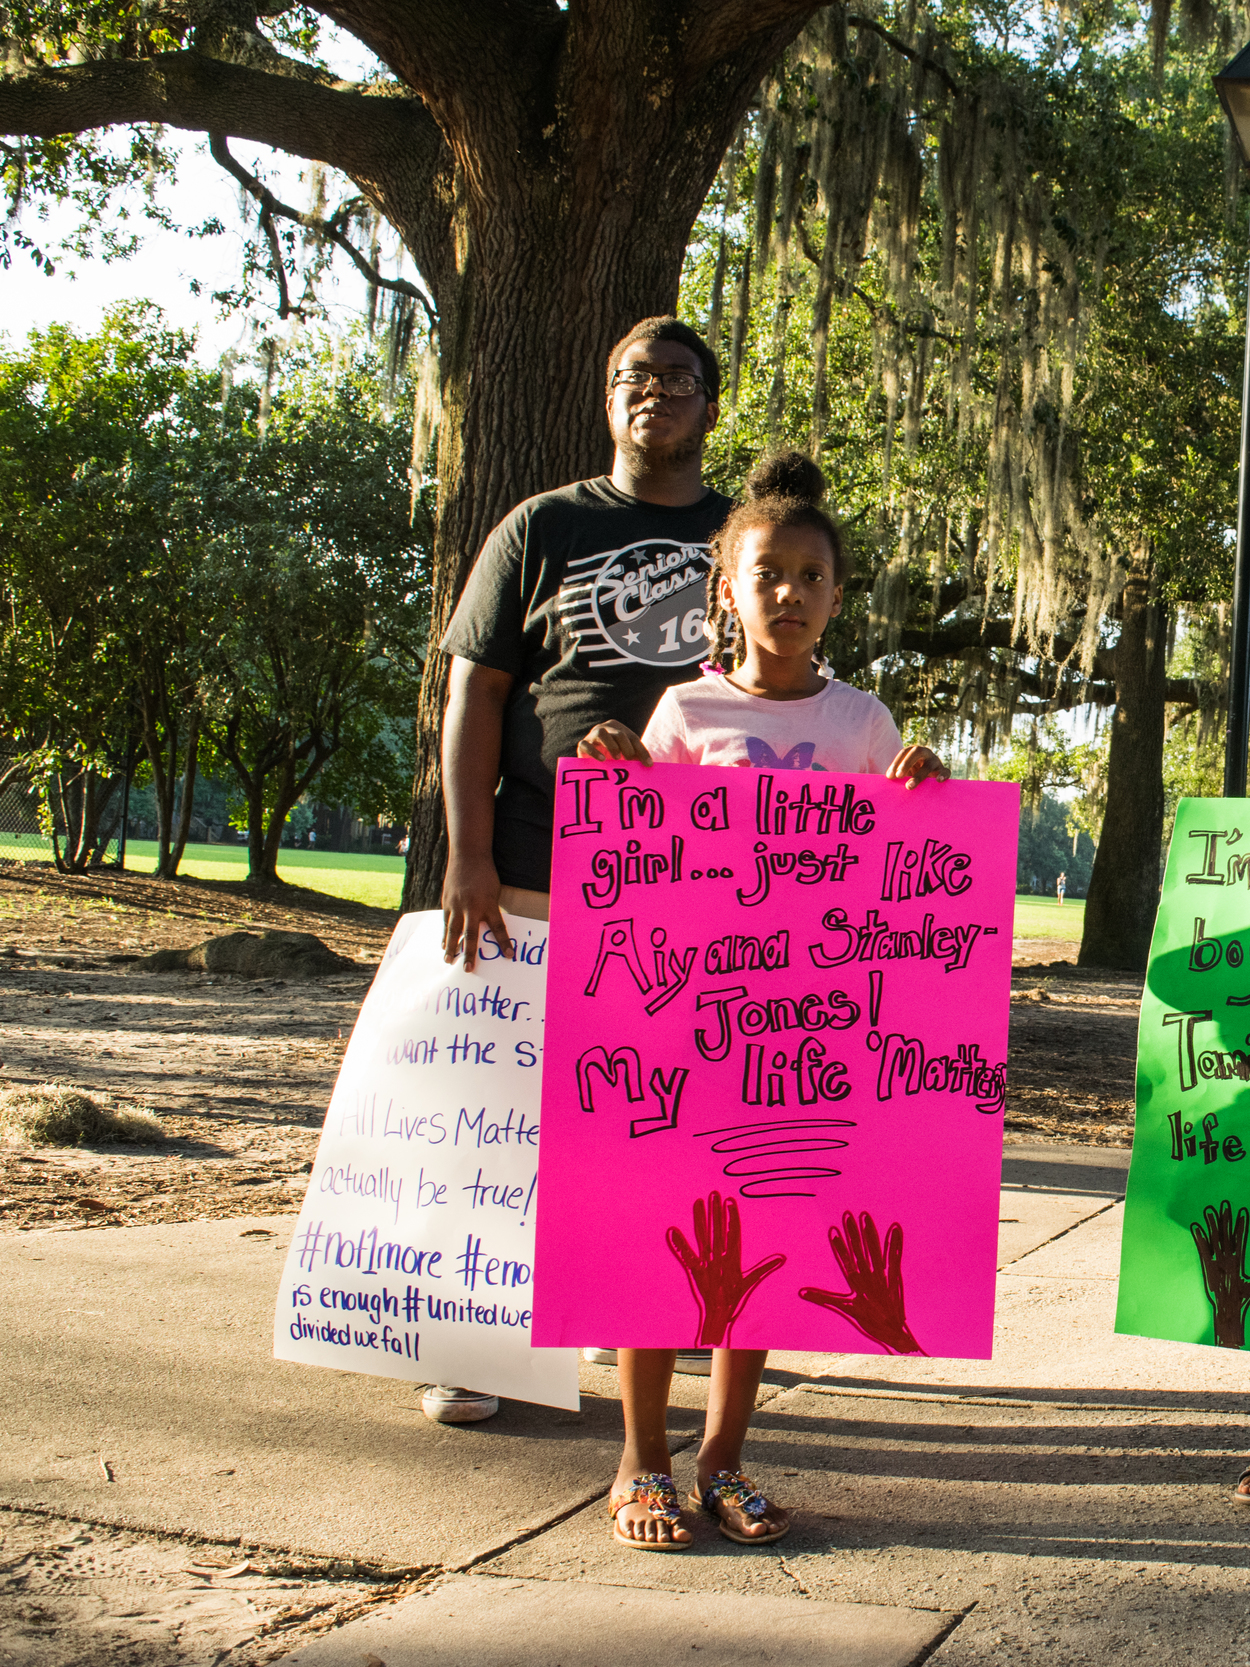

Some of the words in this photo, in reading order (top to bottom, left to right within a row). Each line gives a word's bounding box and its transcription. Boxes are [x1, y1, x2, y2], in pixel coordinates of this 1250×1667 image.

[599, 546, 701, 606] Senior
[614, 566, 706, 624] Class
[657, 607, 706, 654] 16
[560, 768, 664, 838] I'm
[691, 787, 729, 831] a
[757, 775, 876, 835] little
[583, 836, 733, 909] girl...
[737, 842, 859, 906] just
[881, 839, 973, 902] like
[809, 908, 998, 973] Stanley-
[694, 970, 884, 1062] Jones!
[386, 1036, 438, 1065] want
[446, 1033, 497, 1064] the
[340, 1089, 377, 1137] All
[576, 1046, 690, 1138] My
[742, 1037, 852, 1106] life
[1167, 1110, 1246, 1164] life
[320, 1163, 403, 1226] actually
[416, 1167, 448, 1209] be
[462, 1167, 538, 1227] true!
[296, 1221, 442, 1278] #not1more
[292, 1283, 312, 1307] is
